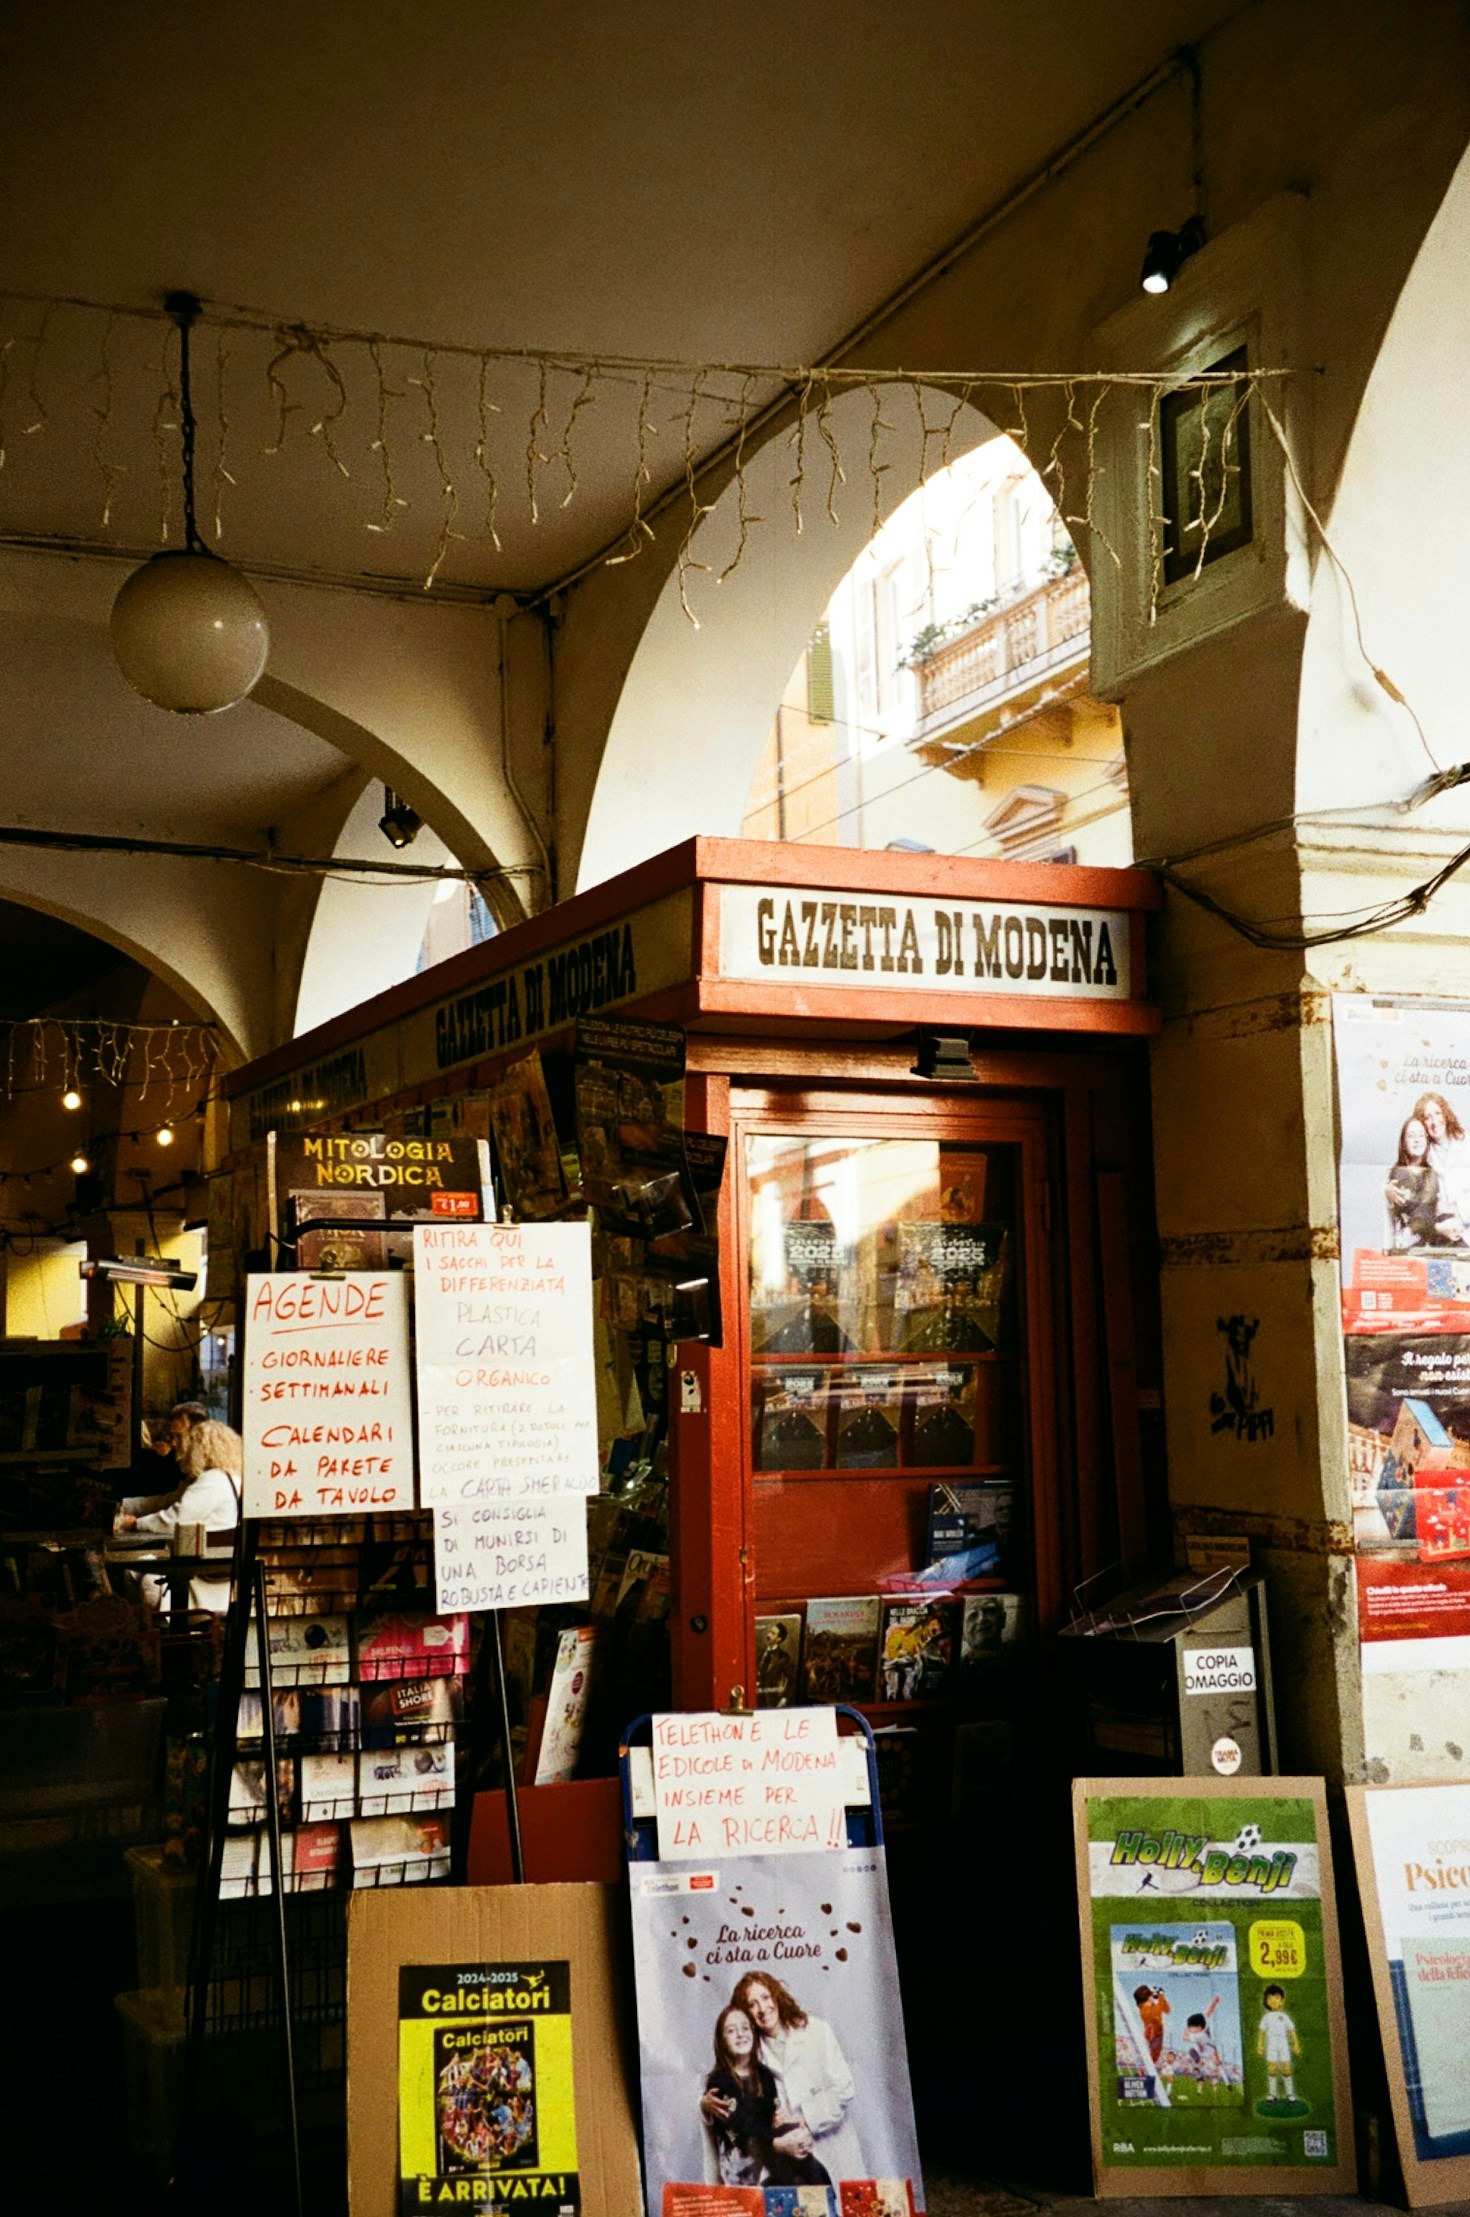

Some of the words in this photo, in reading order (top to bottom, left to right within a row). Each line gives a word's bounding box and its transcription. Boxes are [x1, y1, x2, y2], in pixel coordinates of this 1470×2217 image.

[757, 897, 923, 974] GAZZETTA
[934, 910, 964, 976] DI
[972, 913, 1117, 985] MODENA
[435, 979, 522, 1070] GAZZETTA
[523, 962, 545, 1036] DI
[548, 923, 636, 1026] MODENA
[303, 1134, 453, 1164] MITOLOGIA
[316, 1161, 445, 1188] NORDICA
[423, 1228, 478, 1249] RITIRA
[490, 1231, 522, 1250] QUI
[438, 1255, 488, 1271] SACCHI
[500, 1254, 526, 1270] PER
[536, 1257, 554, 1269] LA
[789, 1246, 845, 1259] 2025
[931, 1247, 985, 1261] 2025
[440, 1275, 566, 1294] DIFFERENZIATA
[252, 1281, 389, 1322] AGENDE
[457, 1301, 541, 1327] PLASTICA
[455, 1335, 536, 1357] CARTA
[262, 1348, 390, 1370] GIORNALIERE
[1415, 1351, 1452, 1371] regalo
[456, 1368, 551, 1387] ORGANICO
[260, 1382, 388, 1402] SETTIMANALI
[435, 1405, 460, 1417] PER
[474, 1403, 533, 1416] RITIRARE
[547, 1404, 565, 1414] LA
[261, 1424, 393, 1448] CALENDARI
[434, 1424, 506, 1436] FORNITURA
[436, 1443, 491, 1454] CIASCUNA
[269, 1460, 297, 1478] DA
[316, 1456, 394, 1476] PARETE
[493, 1454, 571, 1469] PRESENTARE
[274, 1492, 303, 1510] DA
[316, 1485, 397, 1505] TAVOLO
[428, 1487, 448, 1499] LA
[460, 1477, 511, 1499] CARTA
[519, 1475, 597, 1496] SMERALDO
[472, 1506, 546, 1524] CONSIGLIA
[443, 1538, 458, 1553] DI
[474, 1530, 538, 1550] MUNIRSI
[552, 1527, 567, 1543] DI
[441, 1562, 477, 1581] UNA
[495, 1553, 547, 1576] BORSA
[441, 1584, 504, 1609] ROBUSTA
[508, 1585, 517, 1600] E
[522, 1573, 589, 1597] CAPIENTE
[1196, 1655, 1238, 1670] COPIA
[397, 1682, 432, 1699] ITALIA
[1185, 1672, 1253, 1690] OMAGGIO
[399, 1691, 433, 1709] SHORE
[655, 1718, 744, 1747] TELETHON
[784, 1718, 810, 1739] LE
[658, 1754, 734, 1780] EDICOLE
[761, 1749, 836, 1773] MODENA
[664, 1787, 745, 1808] INSIEME
[765, 1786, 798, 1804] PER
[673, 1820, 702, 1846] LA
[1199, 1849, 1297, 1893] Benji
[716, 1925, 741, 1944] La
[742, 1923, 805, 1941] ricerca
[706, 1946, 722, 1965] ci
[725, 1943, 754, 1963] sta
[757, 1947, 770, 1961] a
[773, 1941, 822, 1960] Cuore
[457, 1972, 518, 1985] 2024-2025
[422, 1986, 550, 2013] Calciatori
[442, 2027, 529, 2049] Calciatori
[1113, 2142, 1135, 2153] RBA
[418, 2173, 432, 2202] È
[437, 2177, 566, 2201] ARRIVATA!
